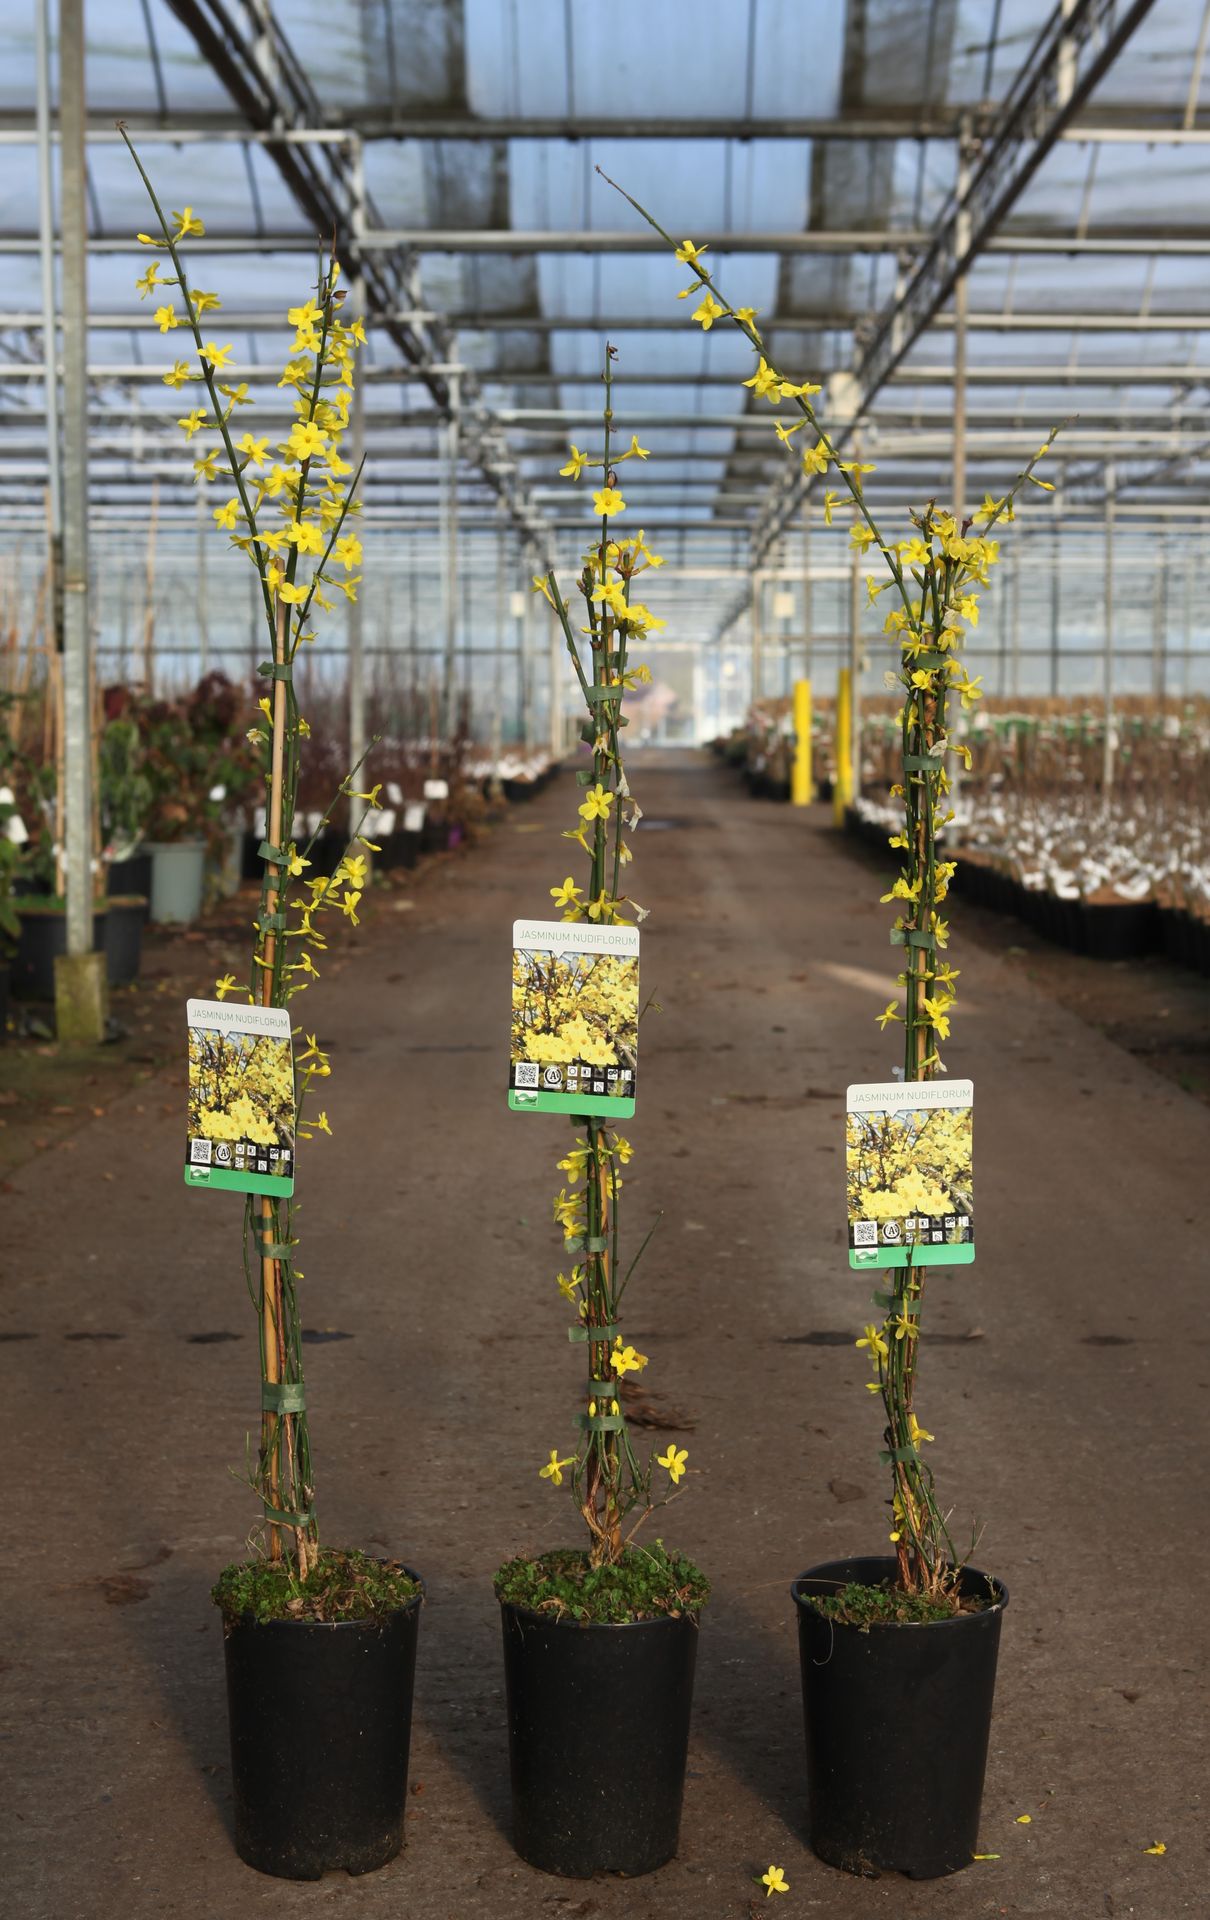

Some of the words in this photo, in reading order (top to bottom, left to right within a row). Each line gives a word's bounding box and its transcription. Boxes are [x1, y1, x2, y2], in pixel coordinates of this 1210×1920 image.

[519, 930, 570, 941] JASMINUM
[573, 933, 637, 946] NUDIFLORUM
[192, 1009, 233, 1022] JASMINUM
[235, 1013, 288, 1028] NUDIFLORUM
[853, 1092, 904, 1103] JASMINUM
[906, 1089, 971, 1101] NUDIFLORUM
